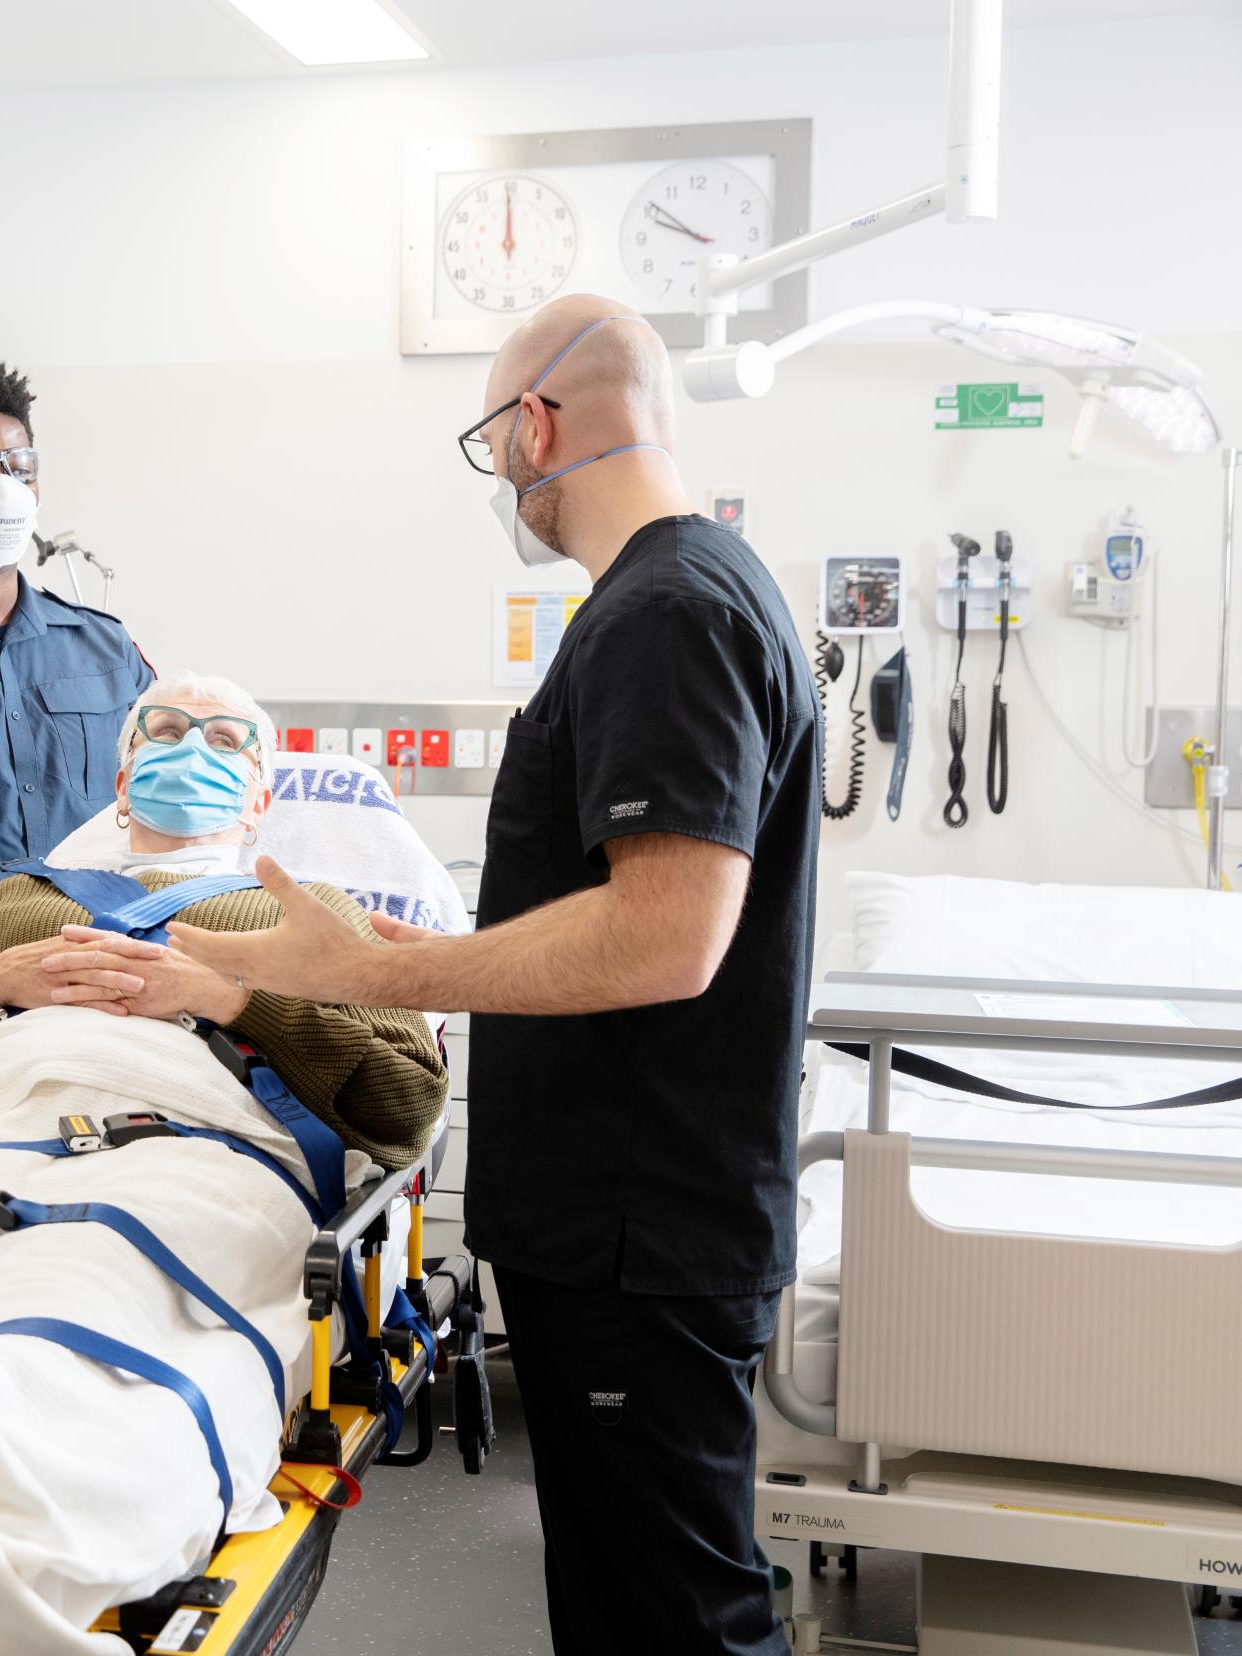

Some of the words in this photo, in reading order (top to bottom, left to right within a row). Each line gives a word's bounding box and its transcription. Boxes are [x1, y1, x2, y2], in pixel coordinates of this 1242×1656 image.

[505, 181, 517, 194] 60
[690, 175, 707, 191] 12
[476, 190, 489, 203] 55
[536, 187, 542, 200] 5
[666, 185, 678, 200] 11
[555, 208, 566, 220] 10
[740, 200, 751, 215] 2
[456, 212, 469, 224] 50
[636, 232, 647, 247] 9
[748, 227, 759, 242] 3
[448, 240, 460, 253] 45
[643, 259, 654, 274] 8
[454, 268, 467, 281] 40
[663, 278, 673, 293] 7
[473, 288, 486, 301] 35
[502, 295, 515, 308] 30
[609, 801, 649, 813] CHEROKEE
[772, 1511, 791, 1524] M7
[794, 1514, 846, 1530] TRAUMA
[1199, 1558, 1242, 1575] HOW
